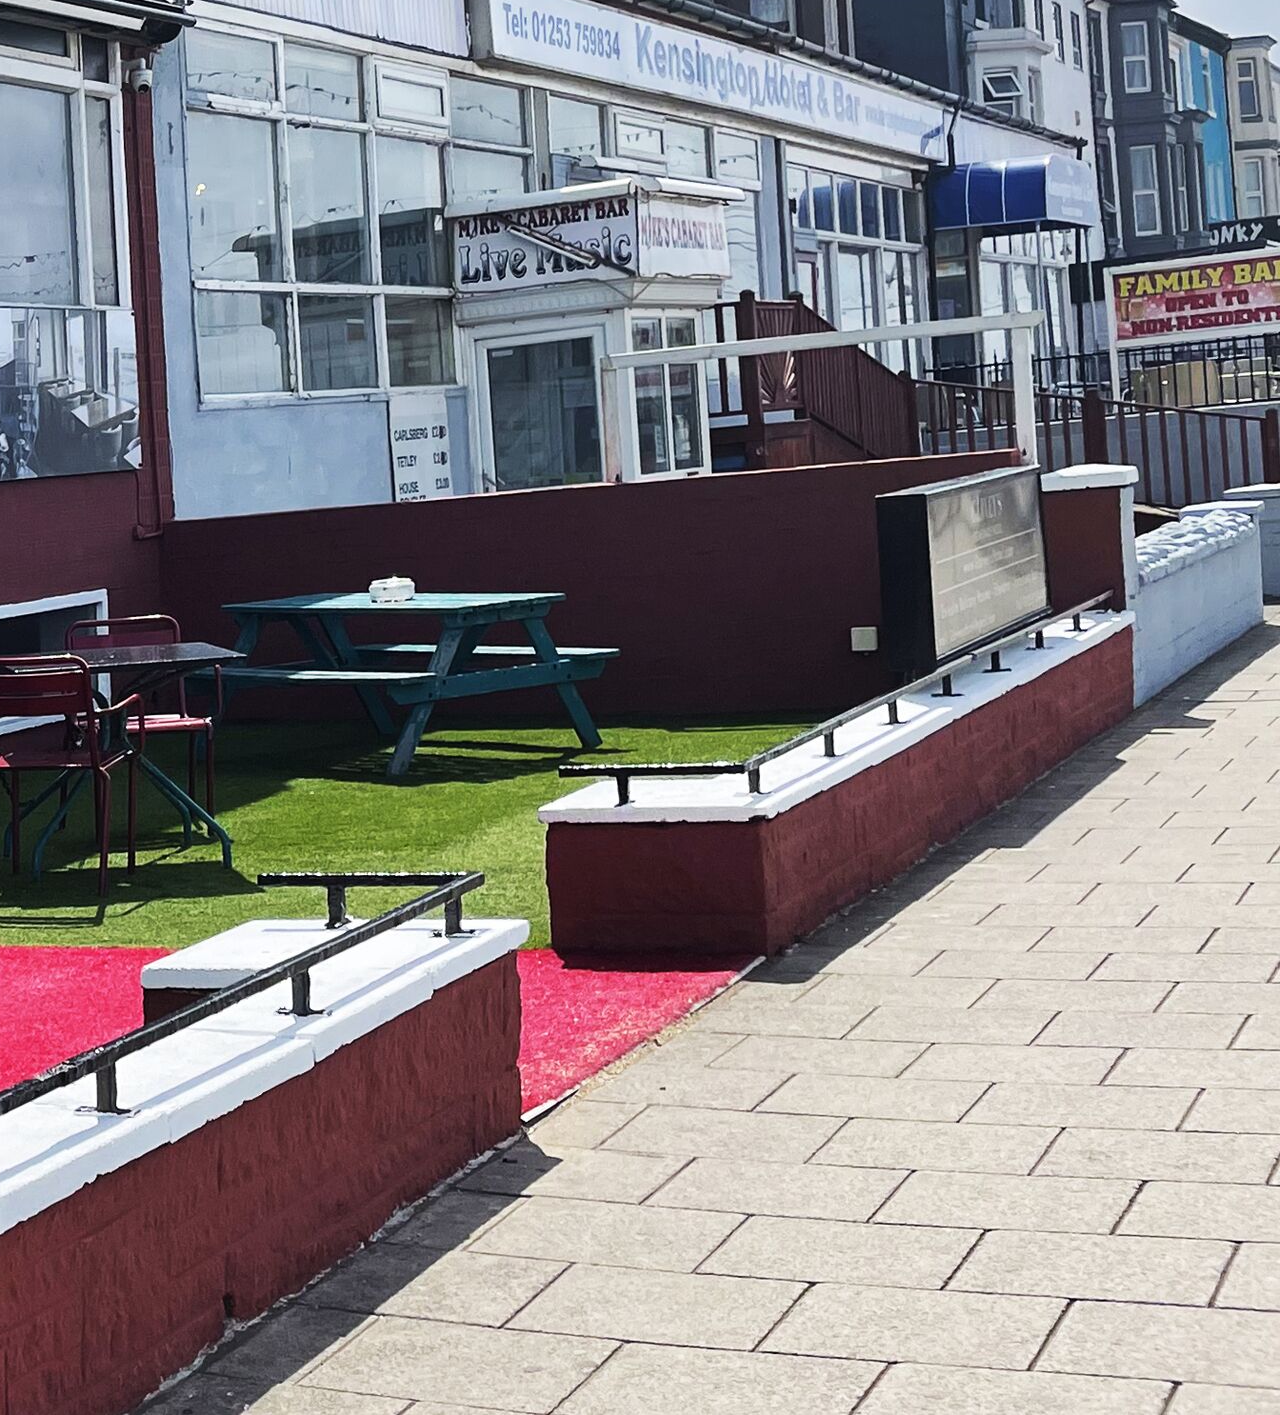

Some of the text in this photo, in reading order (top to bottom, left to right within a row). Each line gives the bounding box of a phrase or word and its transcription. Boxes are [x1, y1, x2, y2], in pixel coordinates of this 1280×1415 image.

[502, 2, 528, 38] Tel:
[531, 10, 571, 50] 01253
[574, 22, 621, 60] 759834
[635, 22, 760, 105] Kensington
[817, 76, 830, 117] &
[833, 80, 860, 125] Bar
[516, 201, 591, 229] CABARET
[594, 198, 630, 220] BAR
[458, 242, 528, 285] Live
[535, 226, 633, 276] Music
[1119, 266, 1224, 297] FAMILY
[1165, 289, 1249, 313] OPEN TO
[393, 426, 428, 442] CARLSBERG
[397, 454, 417, 468] TETLEY
[399, 481, 419, 494] HOUSE
